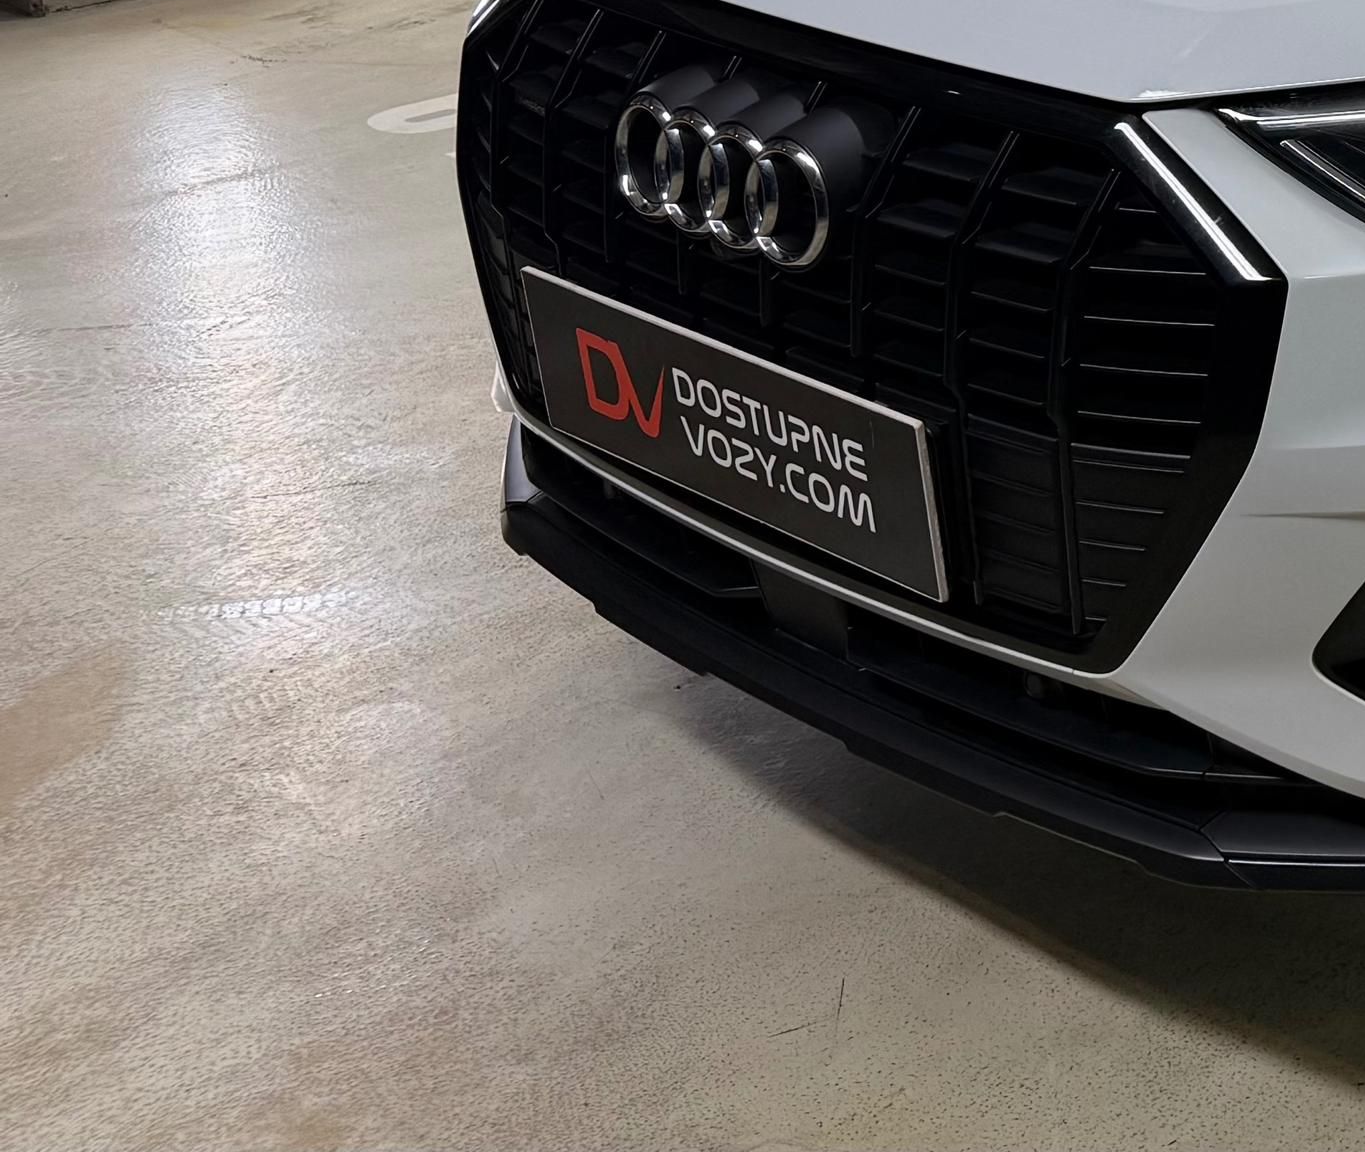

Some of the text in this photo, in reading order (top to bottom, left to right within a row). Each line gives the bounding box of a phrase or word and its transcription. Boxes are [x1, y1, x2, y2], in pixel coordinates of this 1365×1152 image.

[576, 328, 665, 438] DV
[672, 367, 869, 482] DOSTUPNE
[680, 416, 877, 533] VOZY.COM
